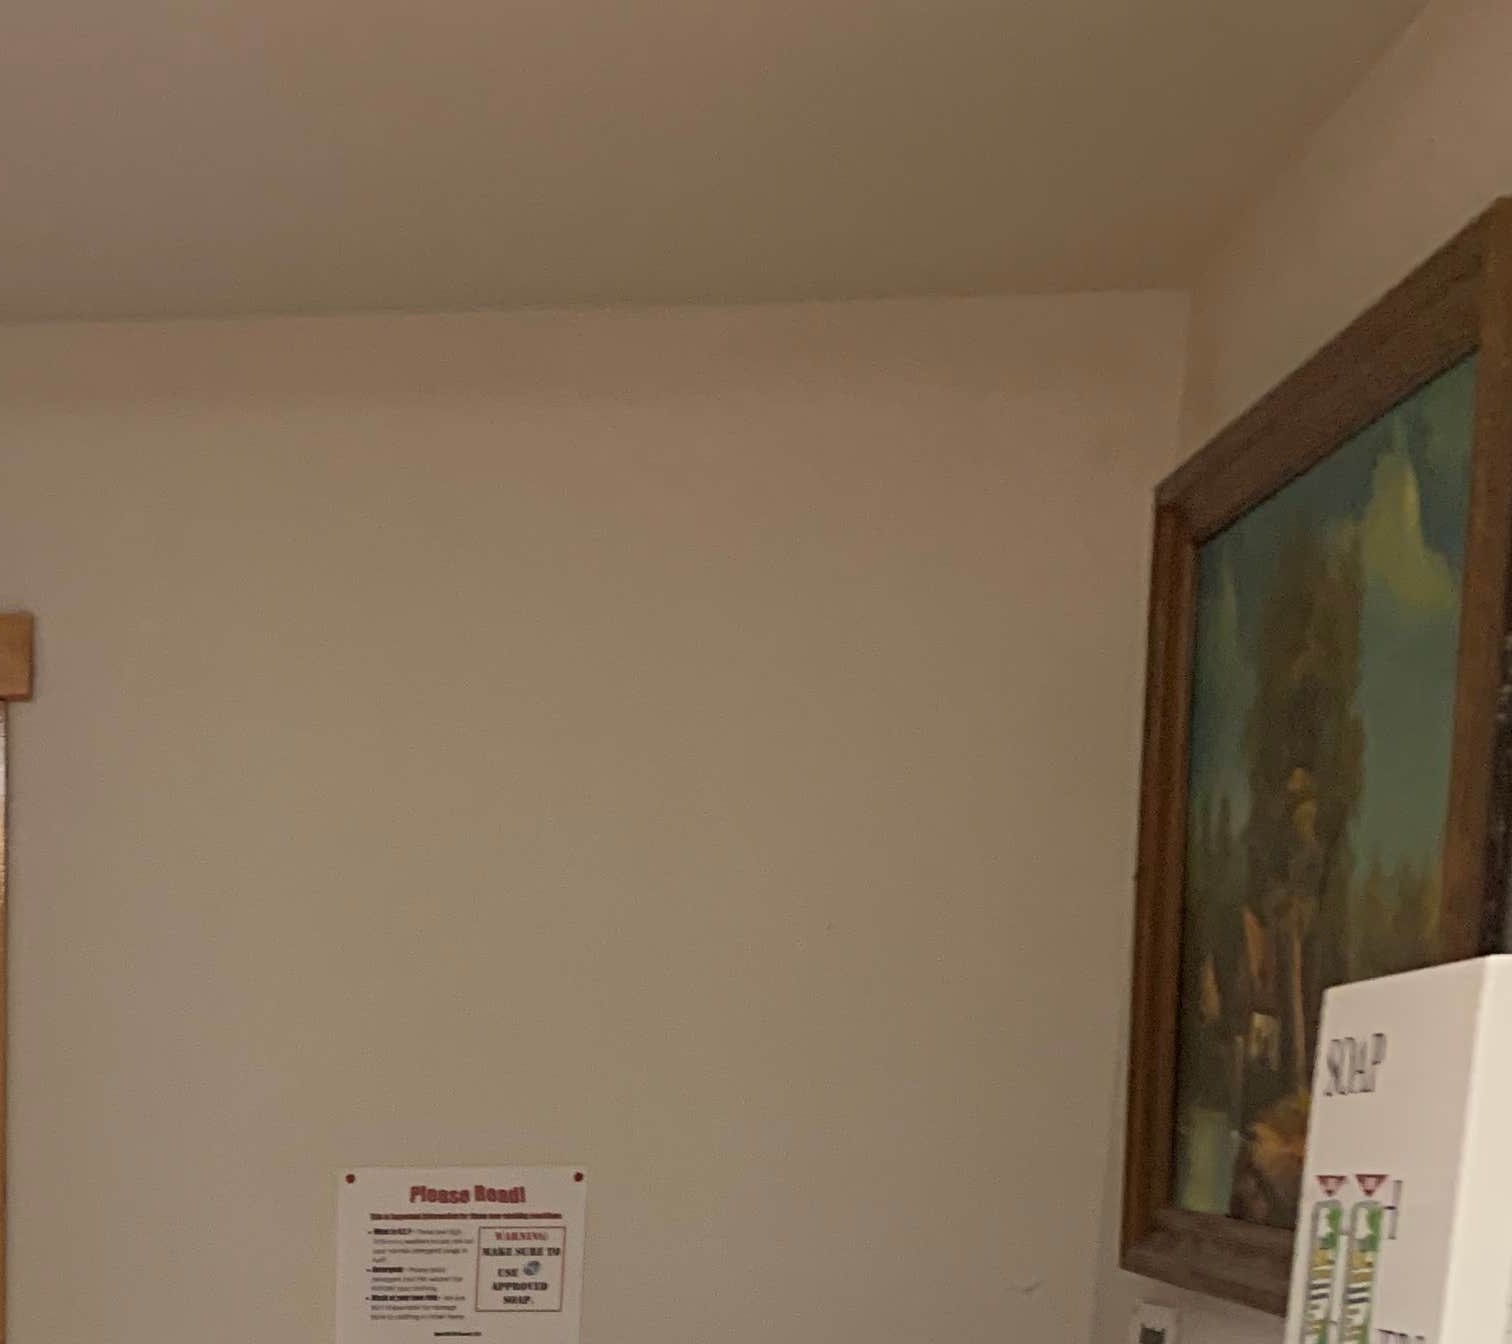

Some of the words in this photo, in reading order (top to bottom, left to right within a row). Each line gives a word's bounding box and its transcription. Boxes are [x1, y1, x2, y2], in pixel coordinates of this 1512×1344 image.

[1323, 1033, 1386, 1097] SOAP
[409, 1185, 471, 1205] Please
[474, 1184, 527, 1204] Read!
